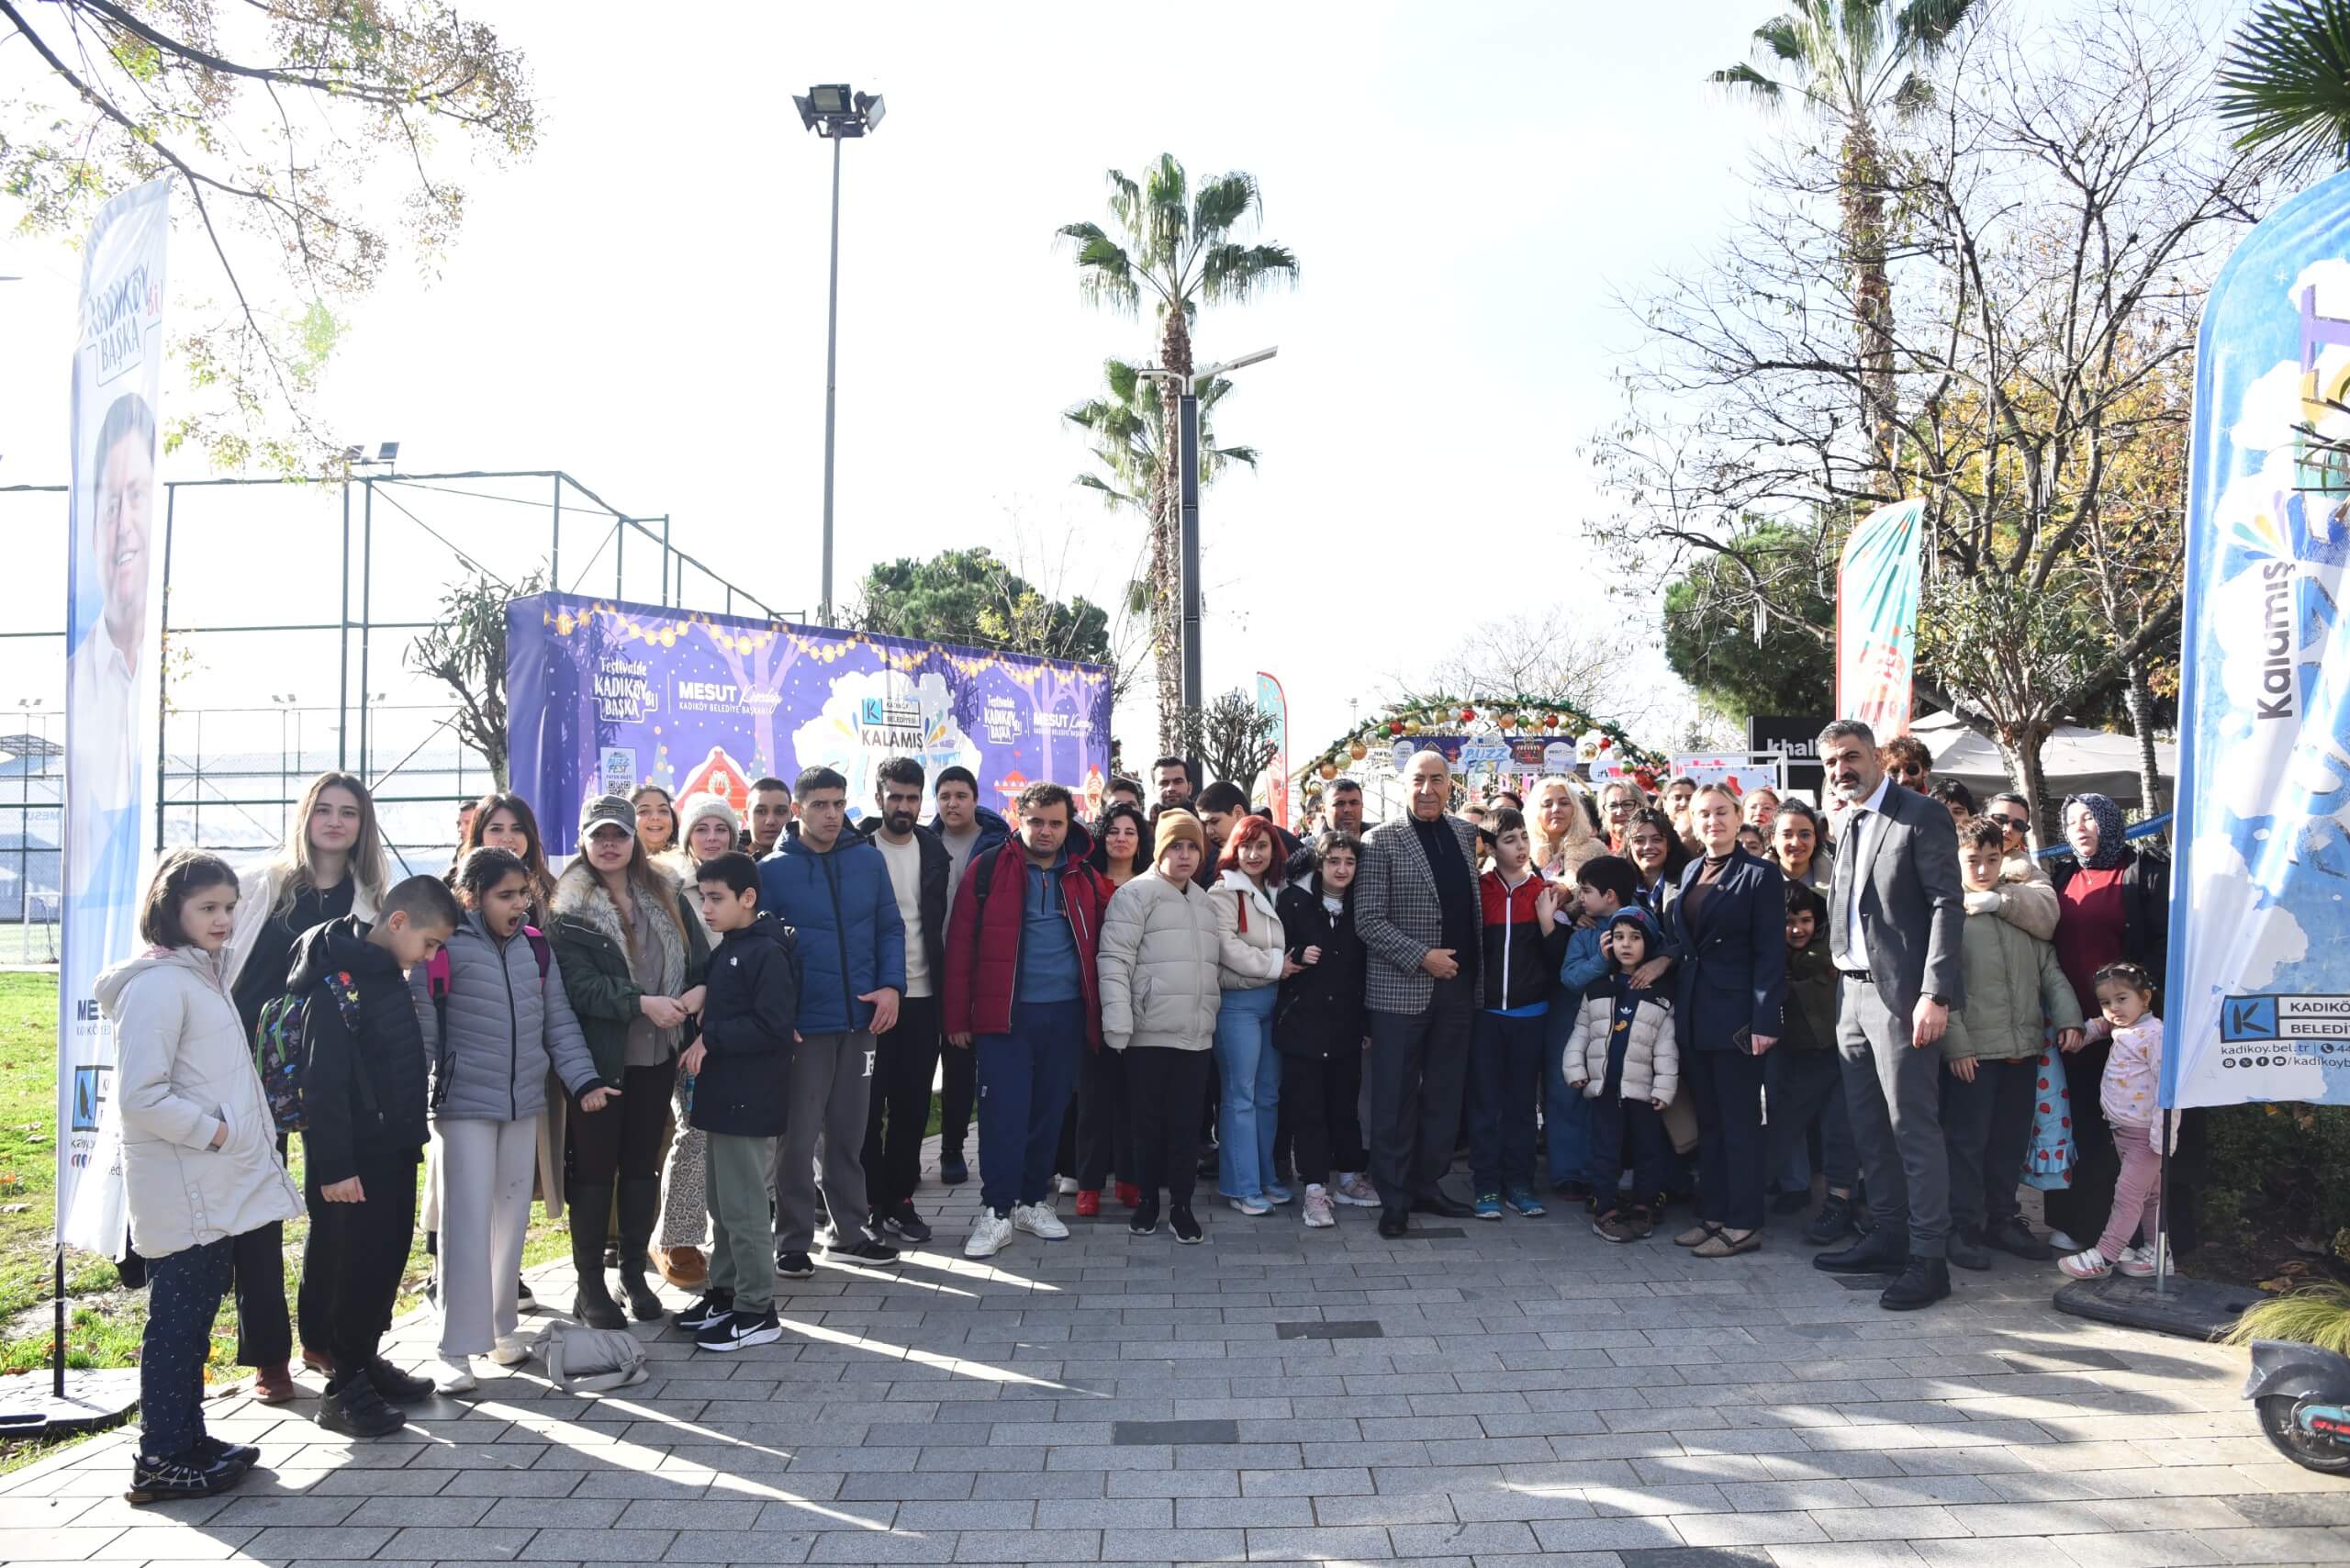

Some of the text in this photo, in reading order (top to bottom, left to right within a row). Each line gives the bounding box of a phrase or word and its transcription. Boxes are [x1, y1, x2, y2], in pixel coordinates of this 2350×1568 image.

[101, 315, 141, 372] BAŞKA
[2256, 561, 2296, 720] Kalamış
[594, 673, 648, 701] KADIKÖY
[678, 681, 737, 702] MESUT
[605, 698, 640, 718] BAŞKA
[1034, 711, 1069, 728] MESUT
[862, 729, 923, 752] KALAMIŞ
[1465, 747, 1506, 759] BUZZ
[1465, 759, 1501, 774] FEST
[2290, 1022, 2350, 1035] BELEDİ
[2221, 1043, 2308, 1056] kadikoy.bel.tr
